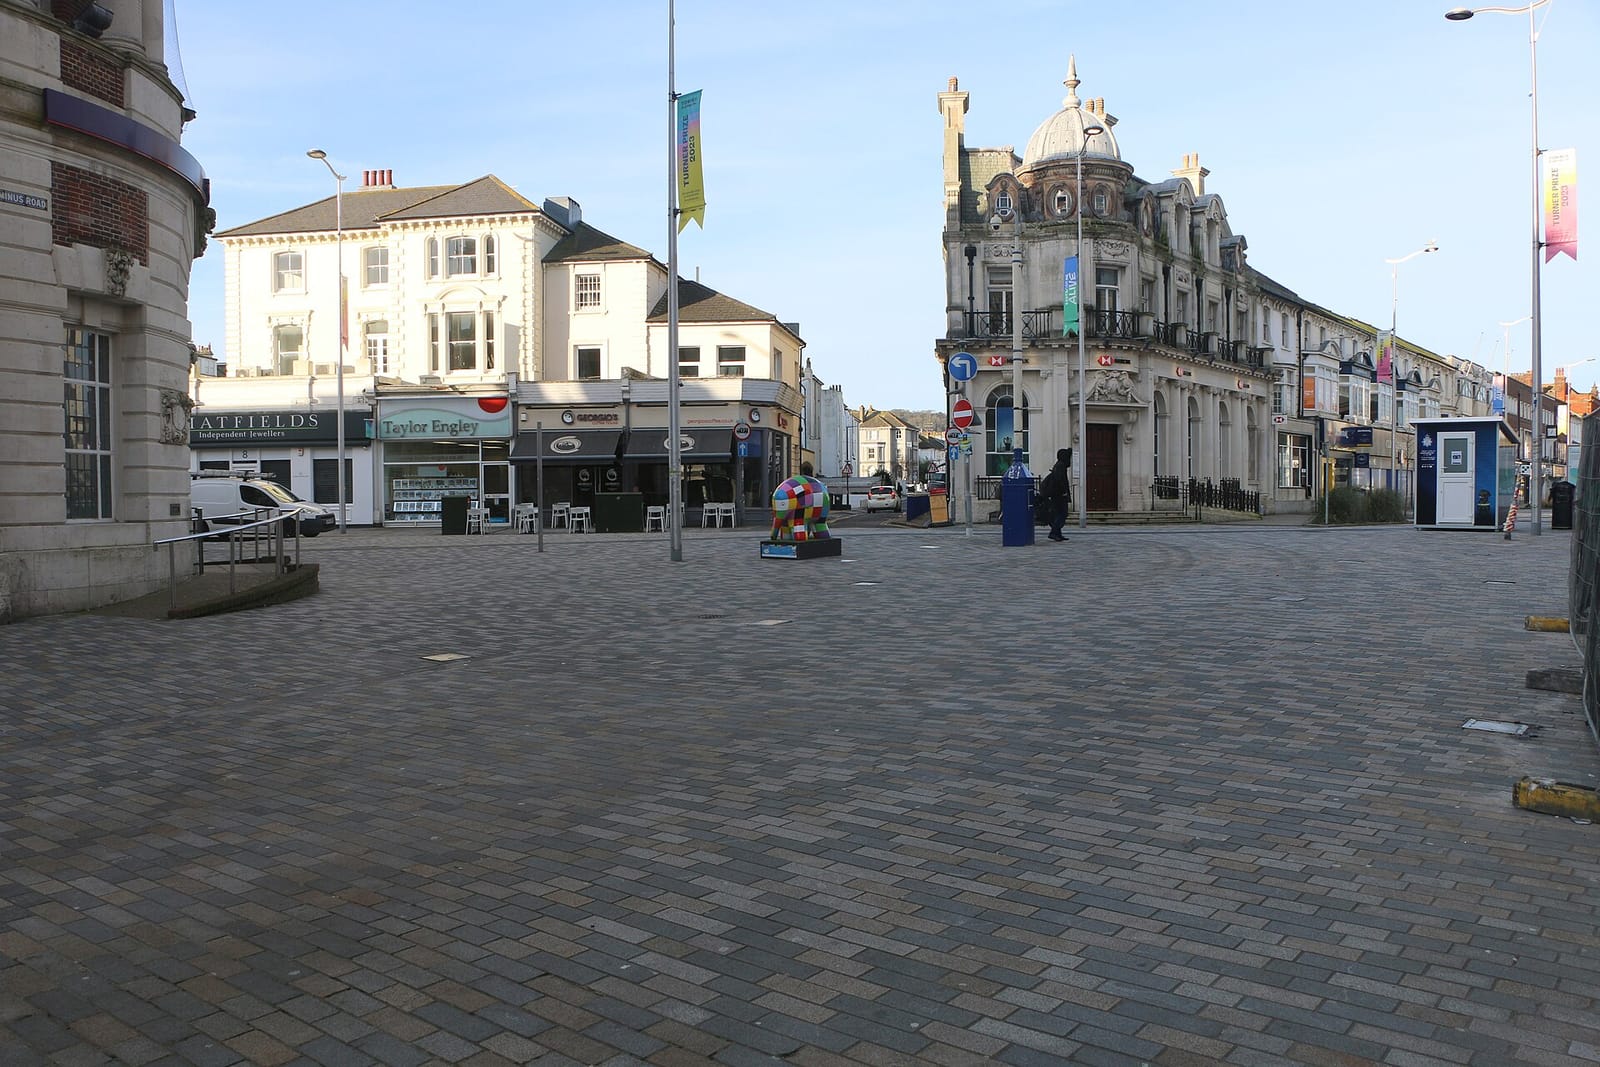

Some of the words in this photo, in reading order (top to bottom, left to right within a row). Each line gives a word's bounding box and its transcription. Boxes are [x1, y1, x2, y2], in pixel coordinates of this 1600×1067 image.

[682, 144, 690, 187] TURNER
[1551, 167, 1559, 191] PRIZE
[25, 196, 46, 209] ROAD
[1552, 192, 1560, 226] TURNER
[1068, 271, 1077, 304] ALIVE
[577, 413, 618, 422] GEORGIO'S
[199, 430, 246, 440] Independent
[249, 430, 285, 439] Jewellers
[383, 420, 428, 437] Taylor
[432, 419, 479, 437] Engley
[242, 450, 248, 459] 8
